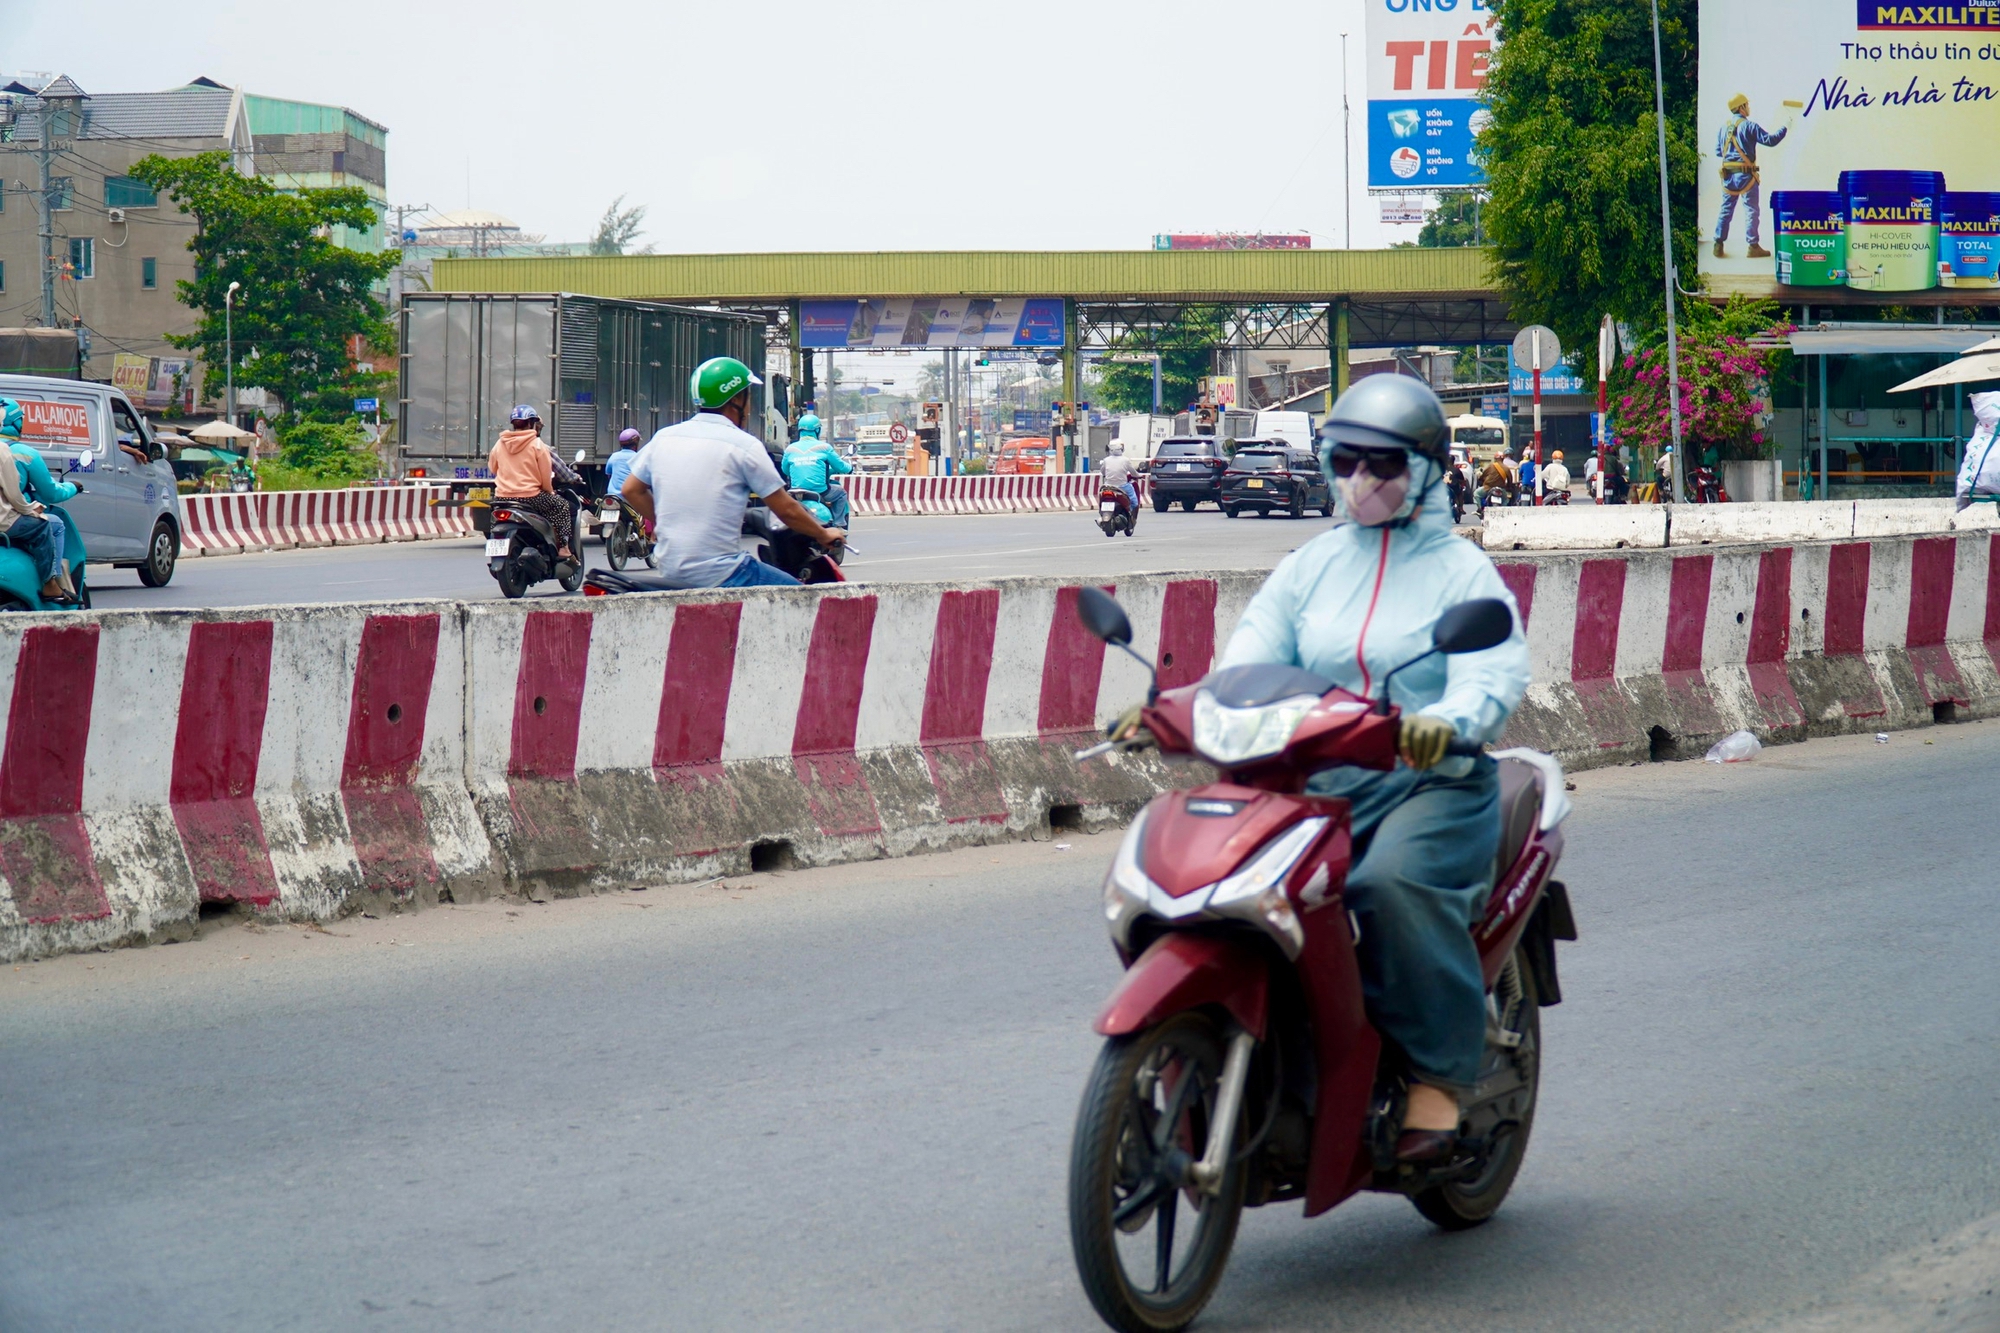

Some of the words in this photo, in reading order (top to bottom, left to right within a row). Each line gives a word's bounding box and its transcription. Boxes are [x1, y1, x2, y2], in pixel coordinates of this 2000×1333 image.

[1877, 7, 2000, 24] MAXILITE
[1840, 43, 1882, 62] Thợ
[1890, 41, 1937, 60] thầu
[1945, 43, 1970, 60] tin
[1804, 75, 1876, 117] Nhà
[1882, 75, 1946, 106] nhà
[1952, 75, 1998, 103] tin
[1851, 207, 1932, 220] MAXILITE
[1781, 220, 1844, 230] MAXILITE
[1794, 239, 1836, 248] TOUGH
[1956, 241, 1993, 250] TOTAL
[719, 376, 742, 393] Grab
[27, 404, 87, 428] LALAMOVE
